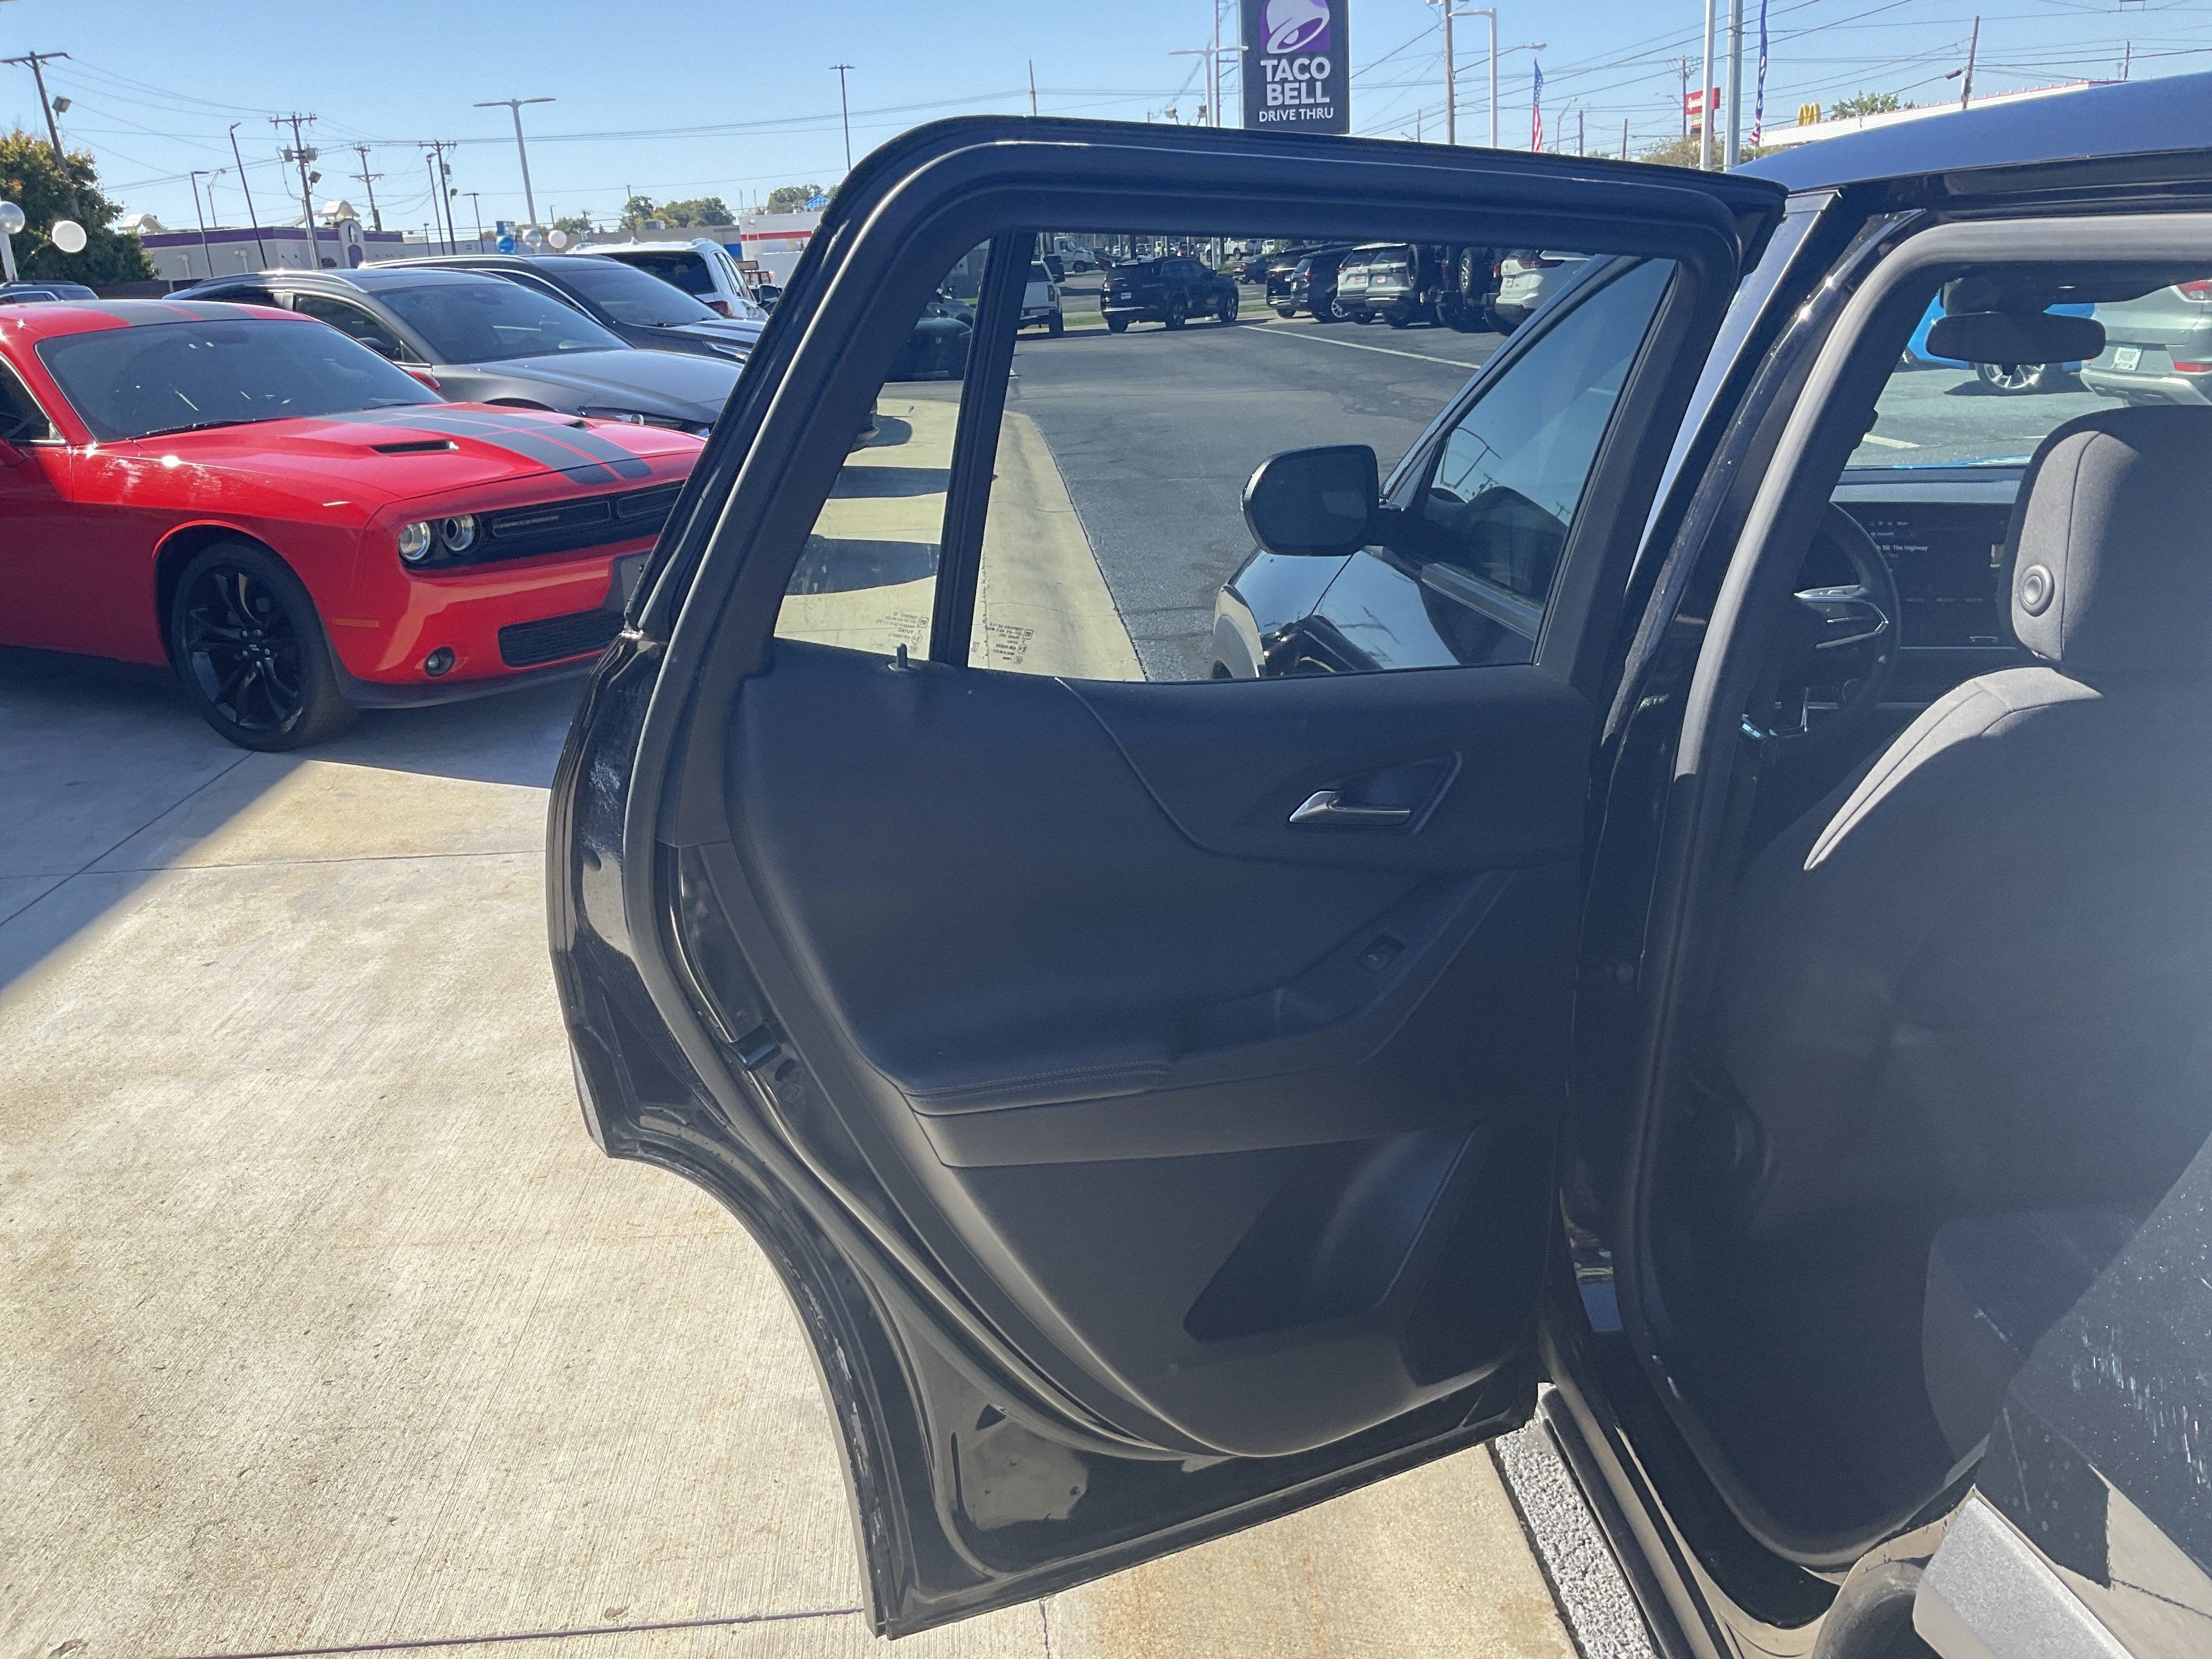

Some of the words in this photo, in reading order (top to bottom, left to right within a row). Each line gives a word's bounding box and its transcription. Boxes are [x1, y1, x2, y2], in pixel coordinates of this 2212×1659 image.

[1260, 57, 1330, 82] TACO
[1267, 82, 1330, 106] BELL
[1688, 95, 1703, 111] Speed
[1259, 109, 1296, 122] DRIVE
[1299, 108, 1334, 120] THRU
